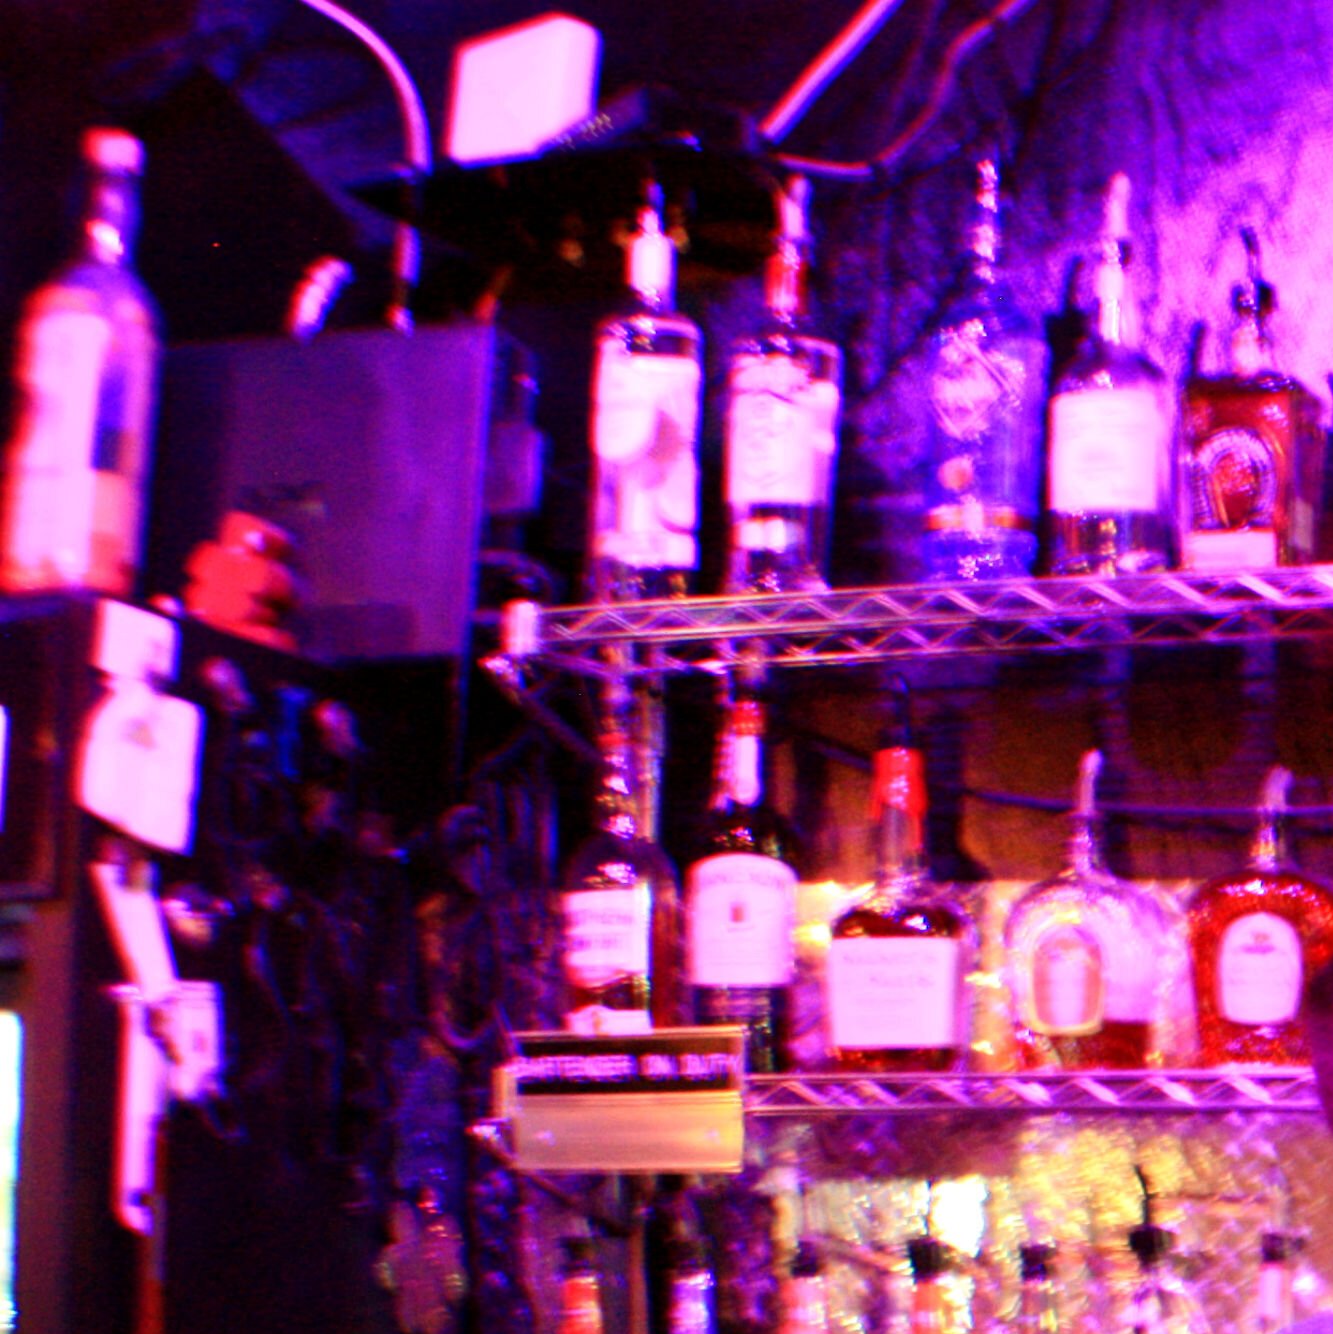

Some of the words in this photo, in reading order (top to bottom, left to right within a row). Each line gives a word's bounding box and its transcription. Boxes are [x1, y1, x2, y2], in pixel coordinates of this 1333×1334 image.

[507, 1054, 637, 1081] BARTENDER
[640, 1053, 677, 1080] ON
[679, 1051, 741, 1080] DUTY
